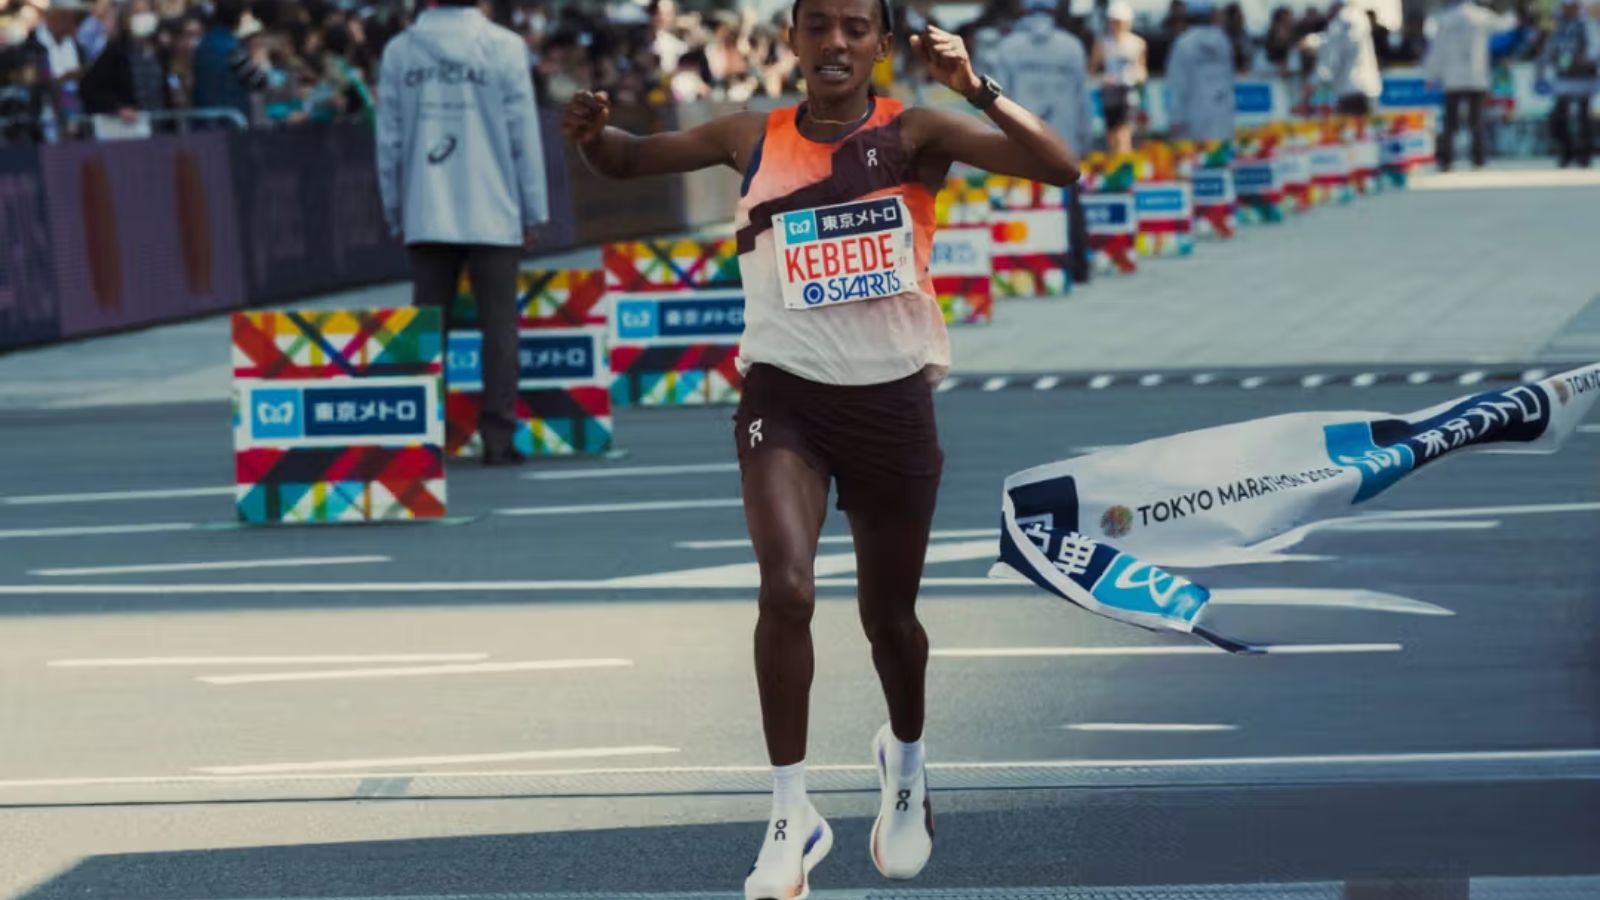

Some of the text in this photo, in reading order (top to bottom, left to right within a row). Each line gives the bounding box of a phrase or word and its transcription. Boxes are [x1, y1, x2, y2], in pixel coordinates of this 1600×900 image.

[821, 205, 898, 232] 東京メトロ
[784, 232, 895, 284] KEBEDE
[314, 400, 417, 422] 東京メトロ
[1137, 490, 1213, 526] TOKYO
[1217, 473, 1305, 506] MARATHON
